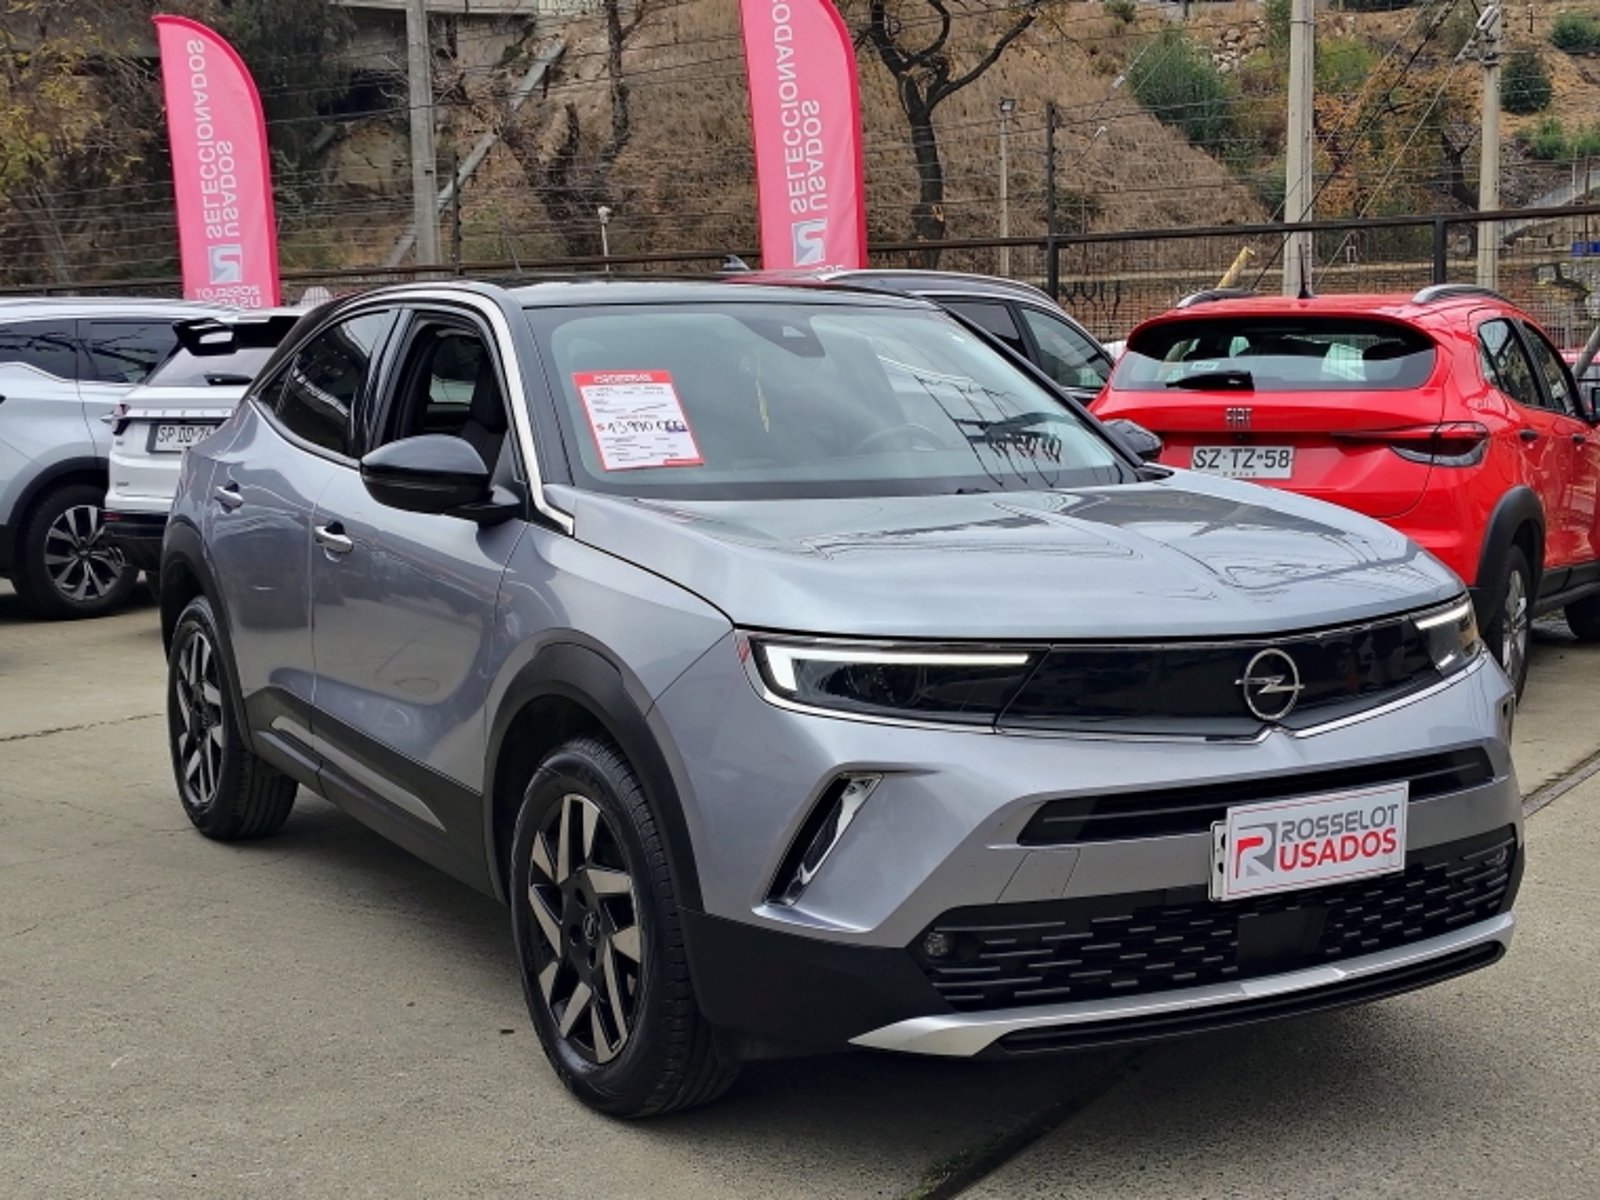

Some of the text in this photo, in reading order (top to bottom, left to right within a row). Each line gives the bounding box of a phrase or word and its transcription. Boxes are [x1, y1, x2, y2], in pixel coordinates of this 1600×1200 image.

[1225, 406, 1253, 428] FIAT
[1281, 804, 1399, 843] ROSSELOT
[1279, 828, 1397, 871] USADOS
